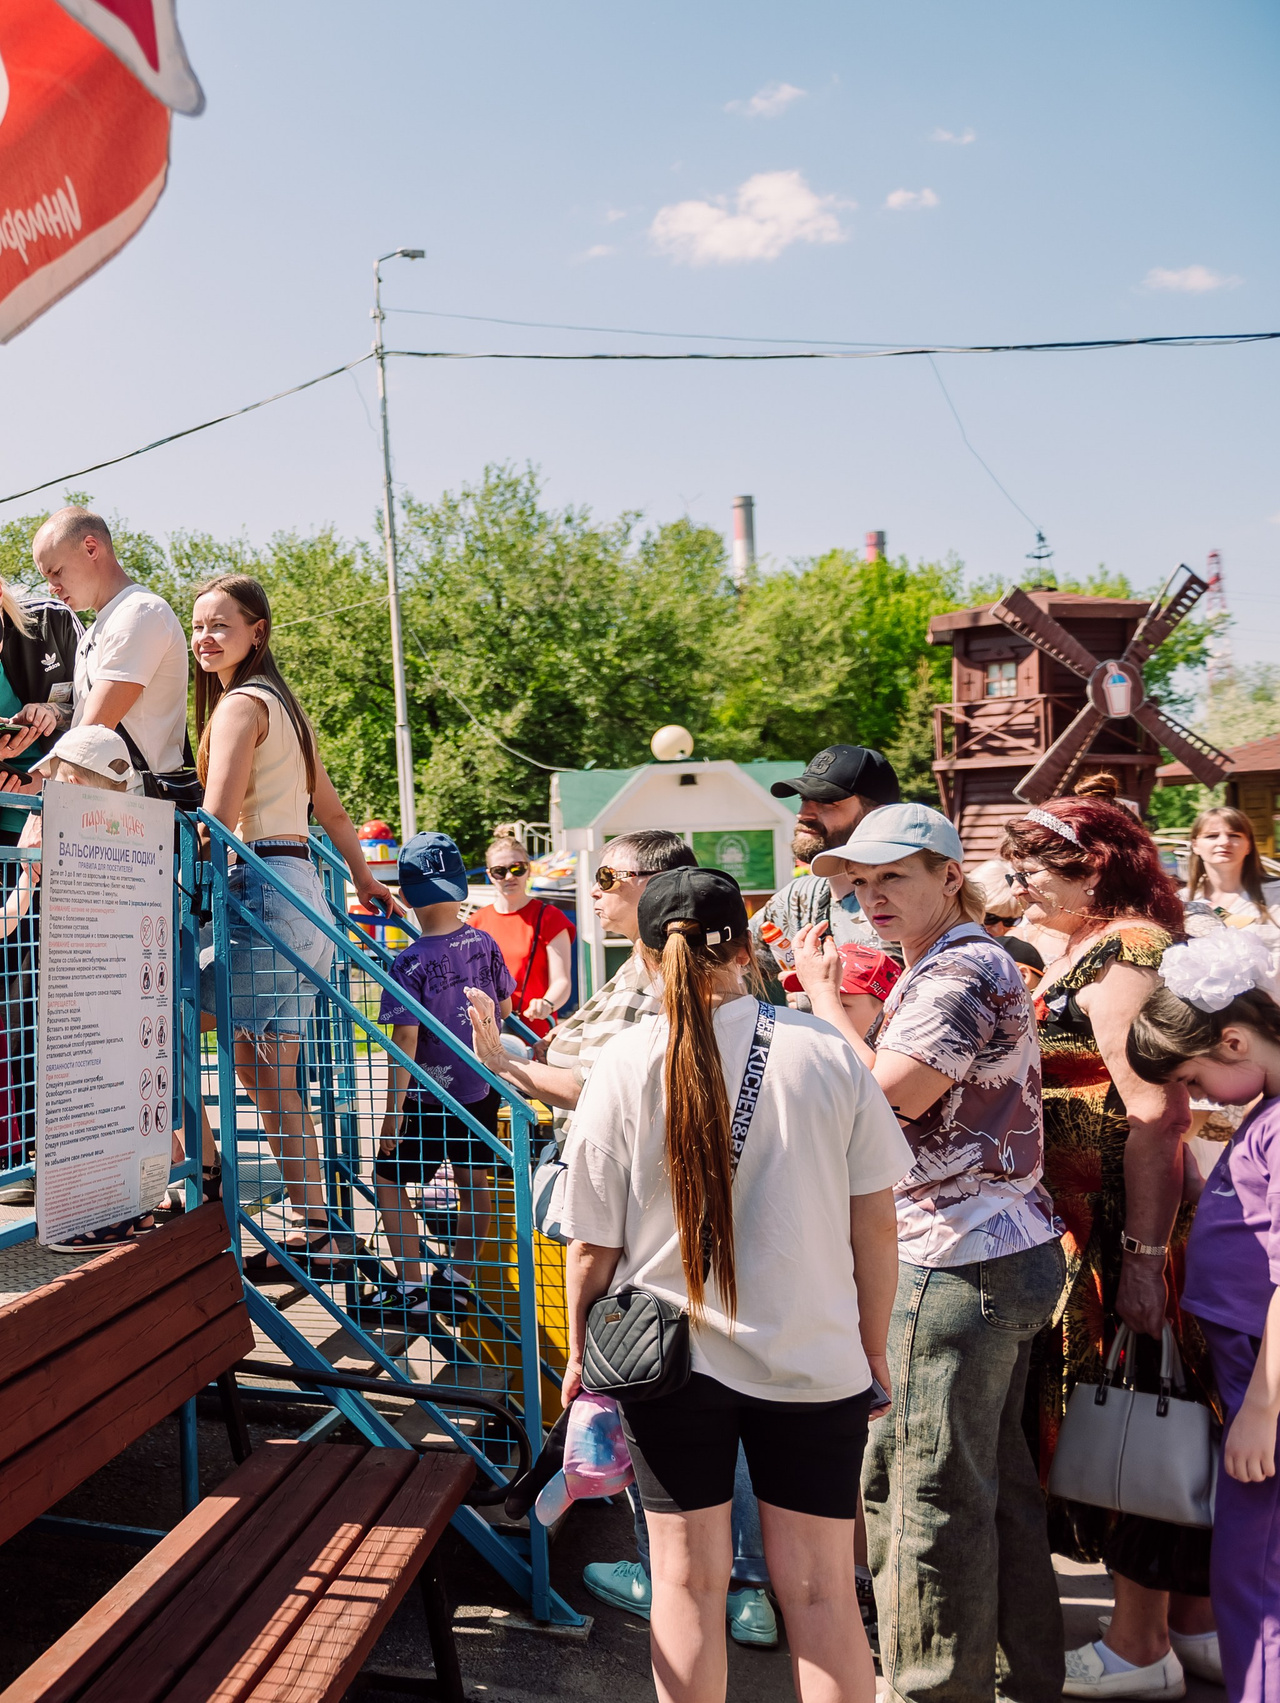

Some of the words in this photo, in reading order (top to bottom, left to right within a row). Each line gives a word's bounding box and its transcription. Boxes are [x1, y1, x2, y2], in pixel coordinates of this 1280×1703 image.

[59, 841, 129, 864] ВАЛЬСИРУЮЩИЕ
[132, 850, 155, 867] ЛОДКИ
[78, 861, 97, 869] ПРАВИЛА
[106, 863, 133, 873] ПОСЕТИТЕЛЕЙ
[45, 1061, 75, 1072] ОБЯЗАННОСТИ
[75, 1058, 101, 1067] ПОСЕТИТЕЛЕЙ
